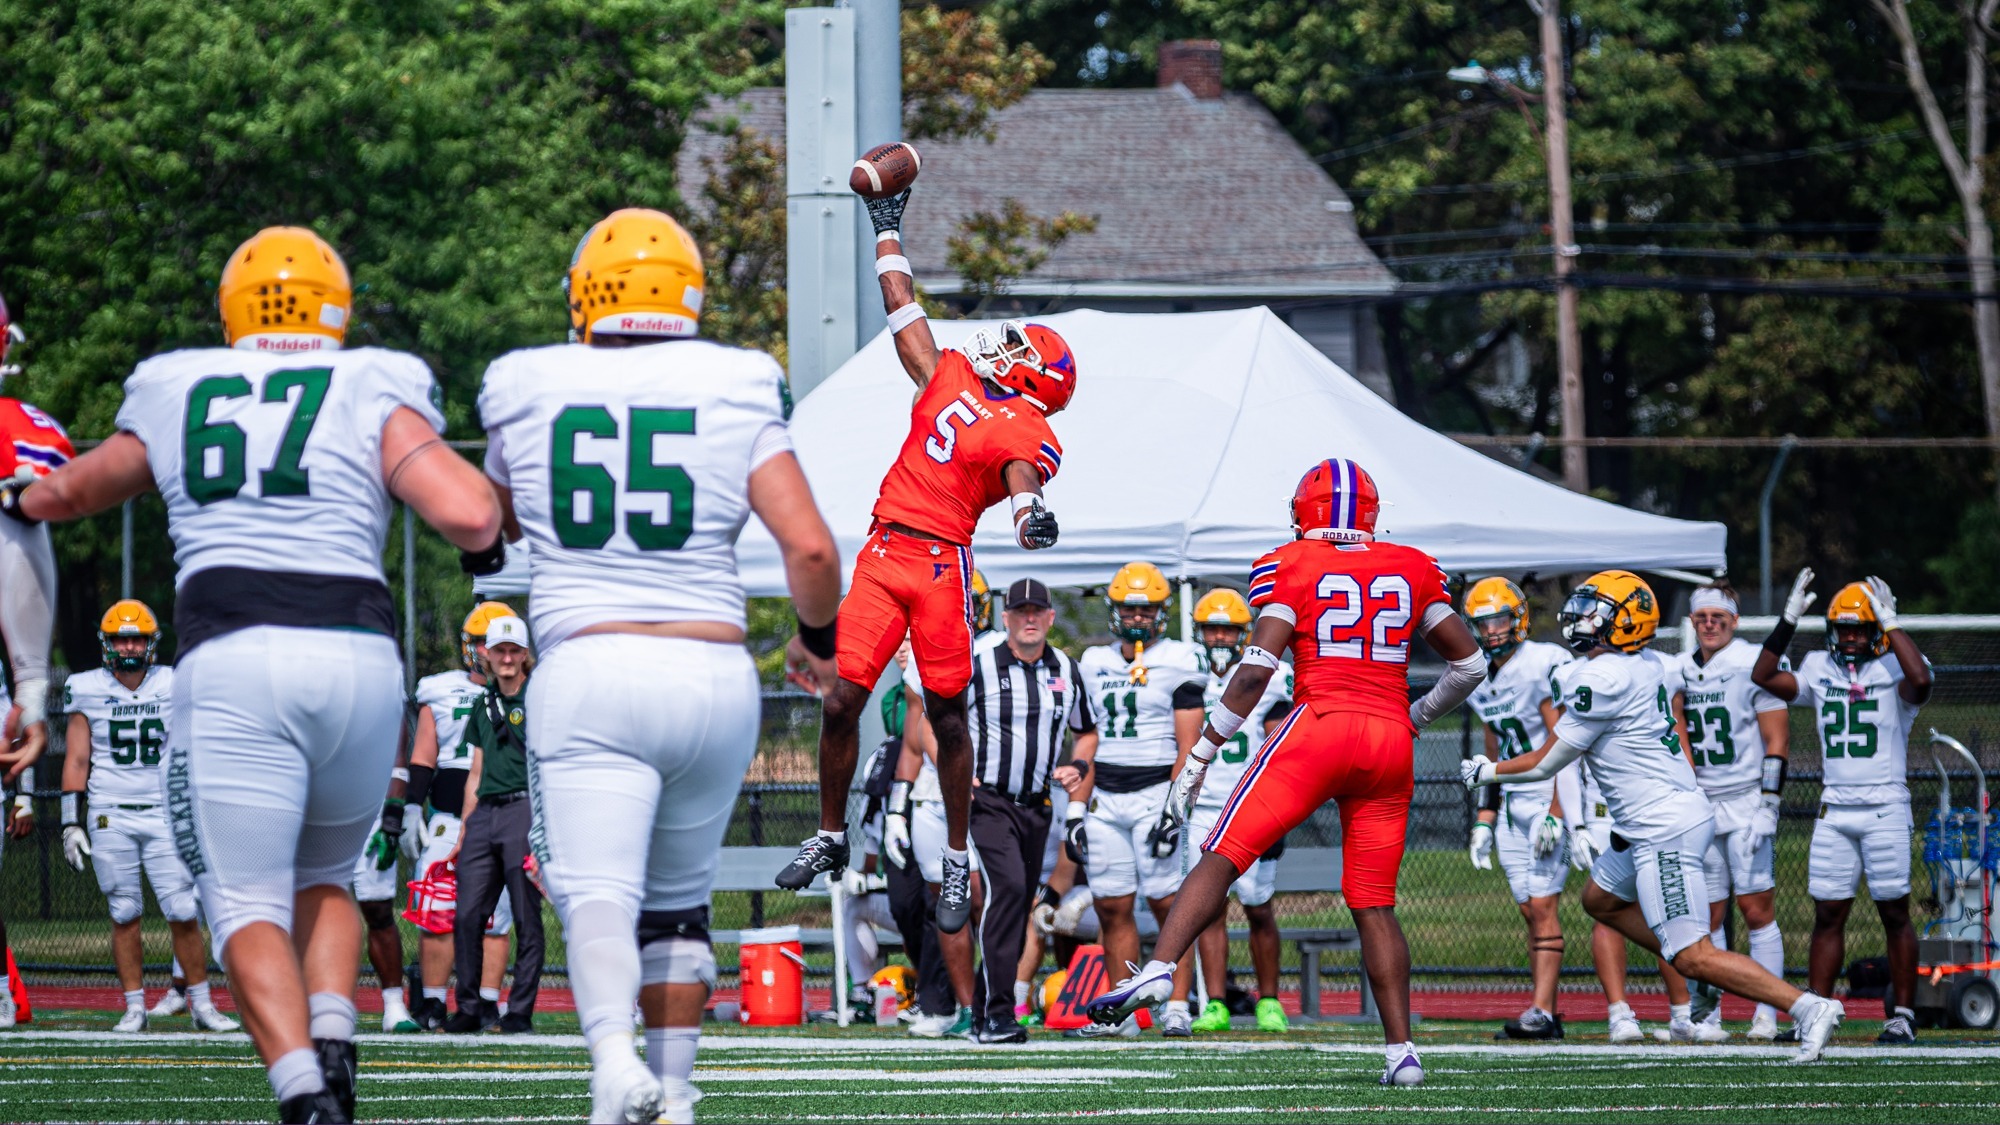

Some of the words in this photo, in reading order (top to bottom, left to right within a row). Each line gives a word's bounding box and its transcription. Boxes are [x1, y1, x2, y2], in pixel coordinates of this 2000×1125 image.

[257, 338, 321, 350] Riddell
[621, 318, 683, 332] Riddell
[183, 366, 334, 503] 67
[925, 398, 979, 464] 5
[960, 390, 994, 420] HOBART
[551, 403, 698, 551] 65
[1322, 531, 1362, 541] HOBART
[1316, 573, 1413, 664] 22
[1103, 691, 1138, 738] 11
[1574, 684, 1593, 714] 3
[1821, 699, 1879, 759] 25
[109, 719, 166, 766] 56
[1684, 705, 1736, 766] 23
[167, 747, 207, 878] BROCKPORT
[1657, 850, 1690, 921] BROCKPORT
[1056, 954, 1106, 1017] 40
